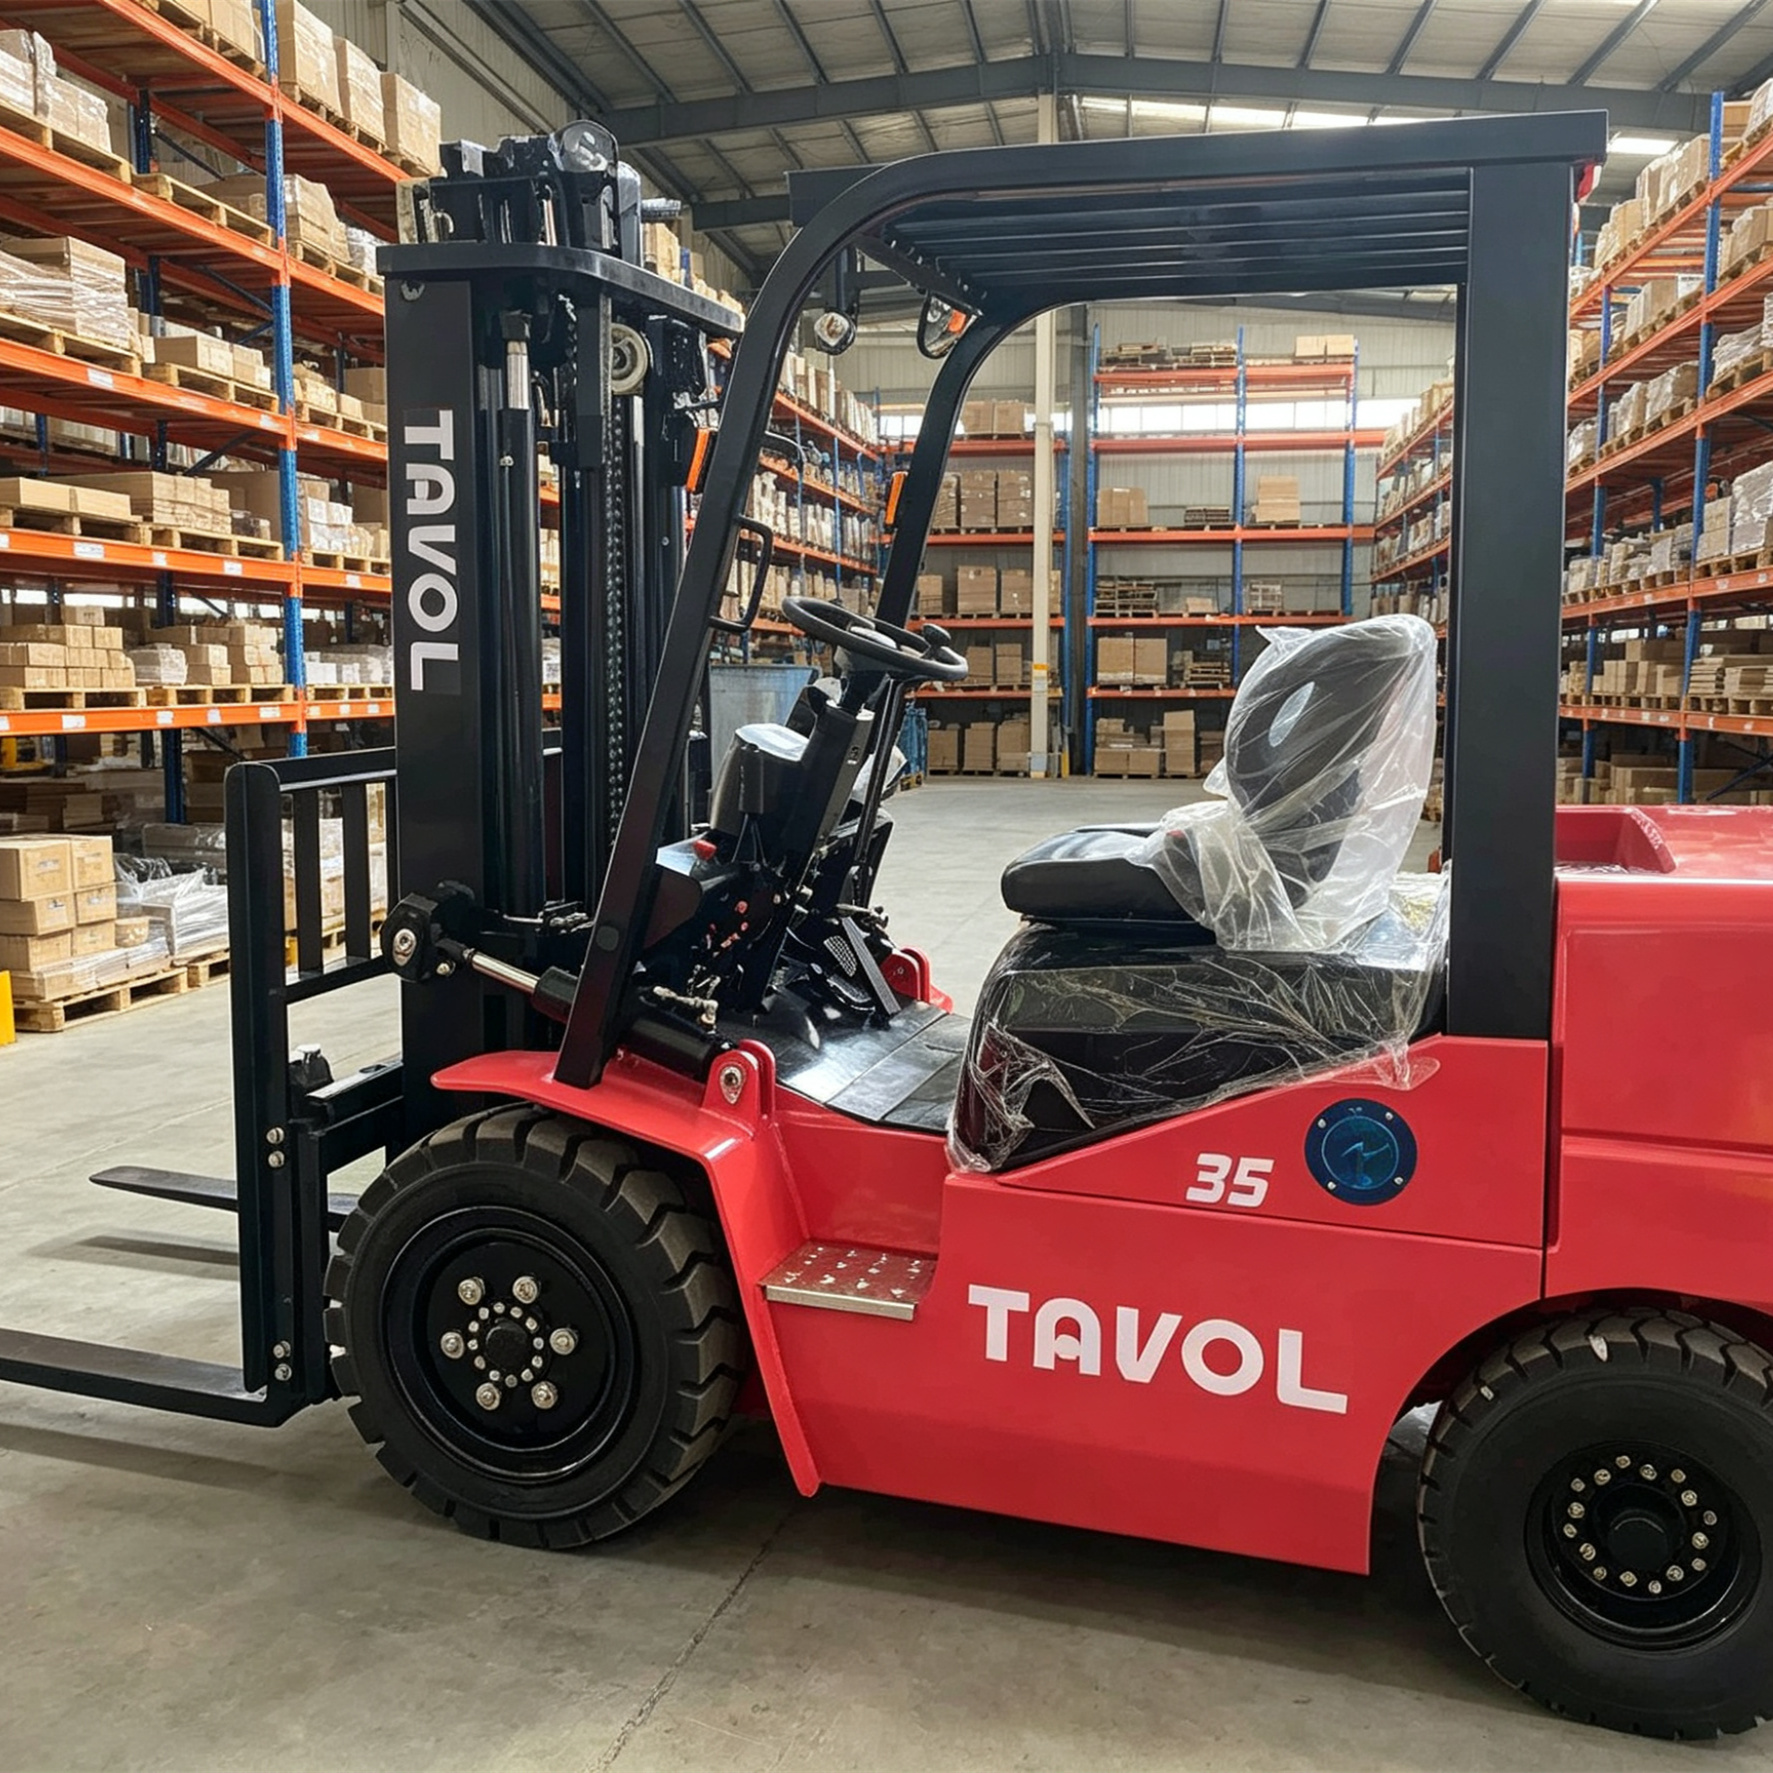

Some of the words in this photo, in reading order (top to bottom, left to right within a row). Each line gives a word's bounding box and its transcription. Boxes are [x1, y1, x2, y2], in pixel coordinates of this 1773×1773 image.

[404, 409, 459, 692] TAVOL
[1185, 1152, 1276, 1208] 35
[967, 1283, 1349, 1415] TAVOL
